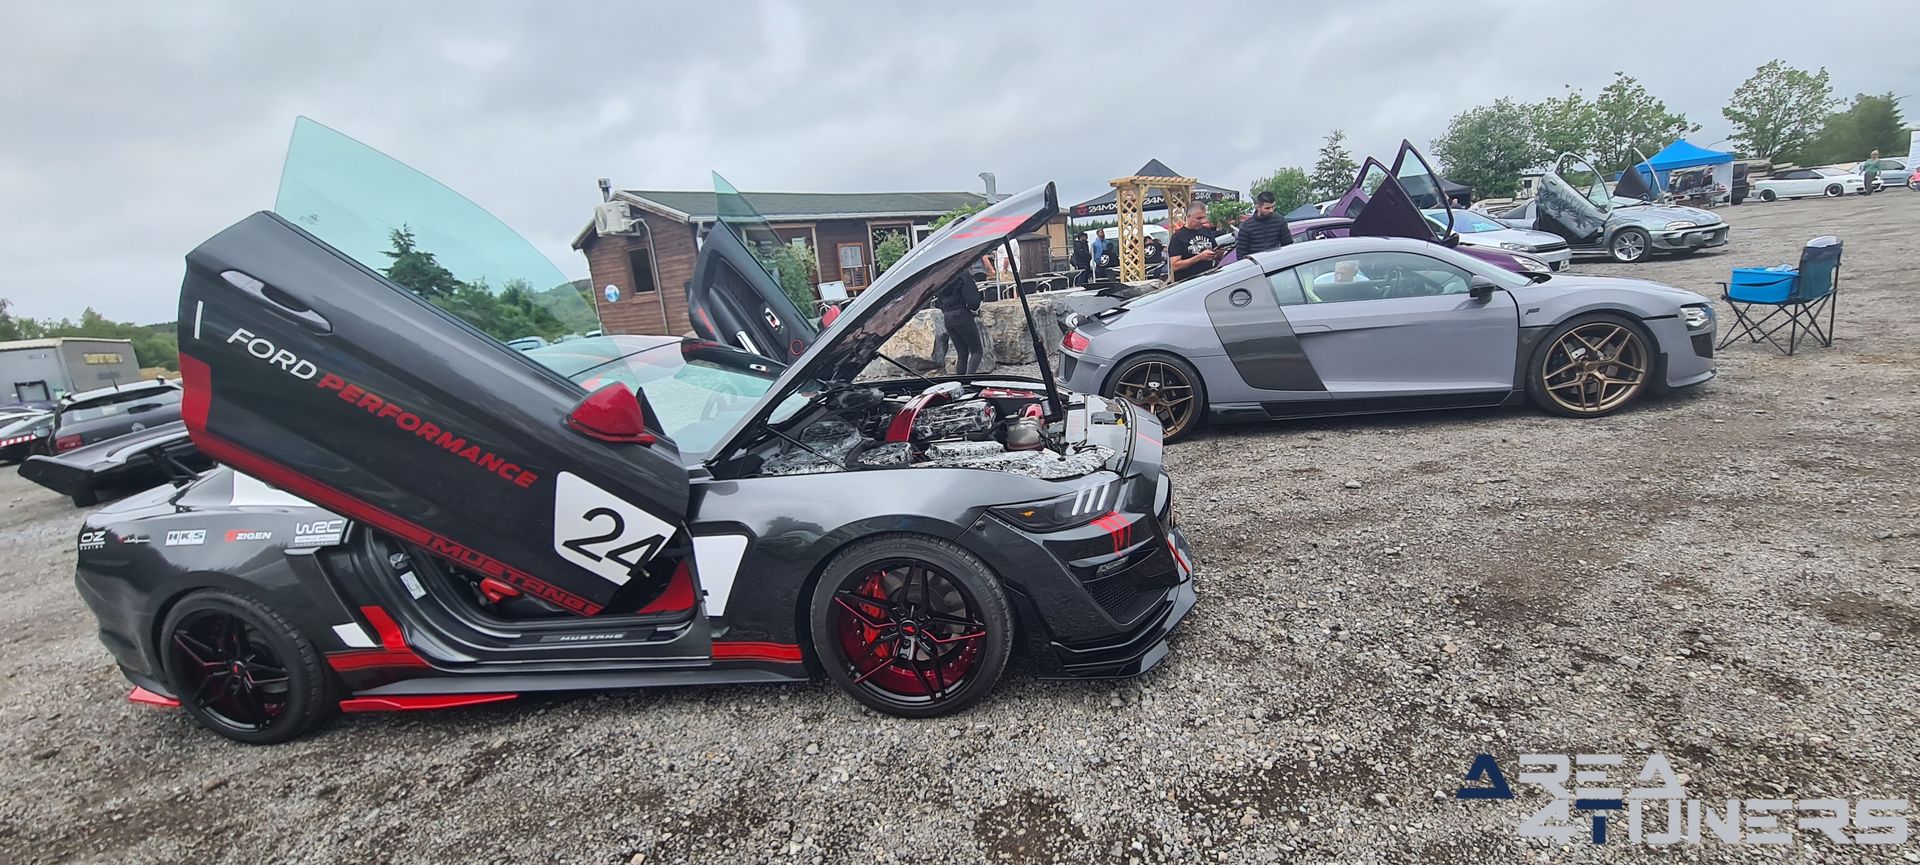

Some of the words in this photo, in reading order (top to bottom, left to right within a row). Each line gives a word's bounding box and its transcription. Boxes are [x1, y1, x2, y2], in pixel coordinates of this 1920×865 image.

[1143, 196, 1165, 206] 24M
[226, 327, 318, 380] FORD
[316, 372, 539, 489] PERFORMANCE
[432, 537, 586, 611] MUSTANG
[561, 507, 667, 577] 24
